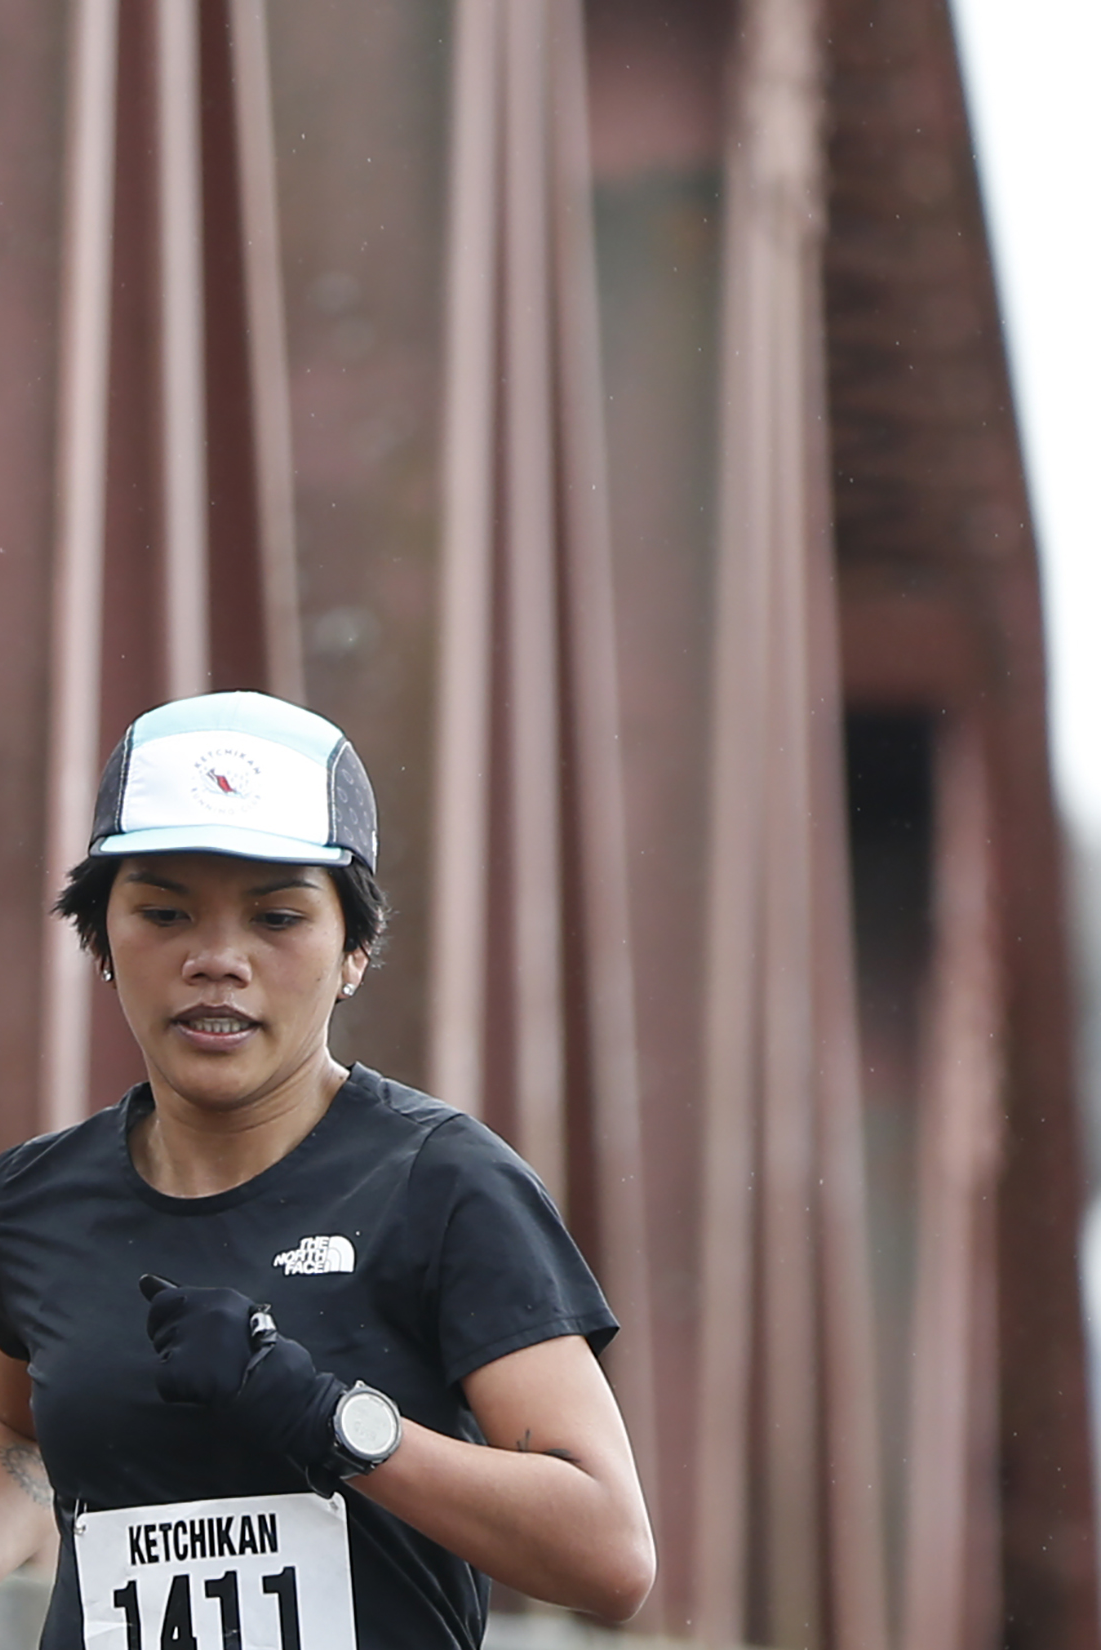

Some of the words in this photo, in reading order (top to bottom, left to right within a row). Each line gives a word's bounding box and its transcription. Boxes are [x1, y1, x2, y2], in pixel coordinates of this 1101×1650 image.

[193, 748, 262, 775] KETCHIKAN
[300, 1236, 329, 1250] THE
[273, 1248, 328, 1267] NORTH
[284, 1261, 325, 1275] FACE
[129, 1513, 279, 1566] KETCHIKAN
